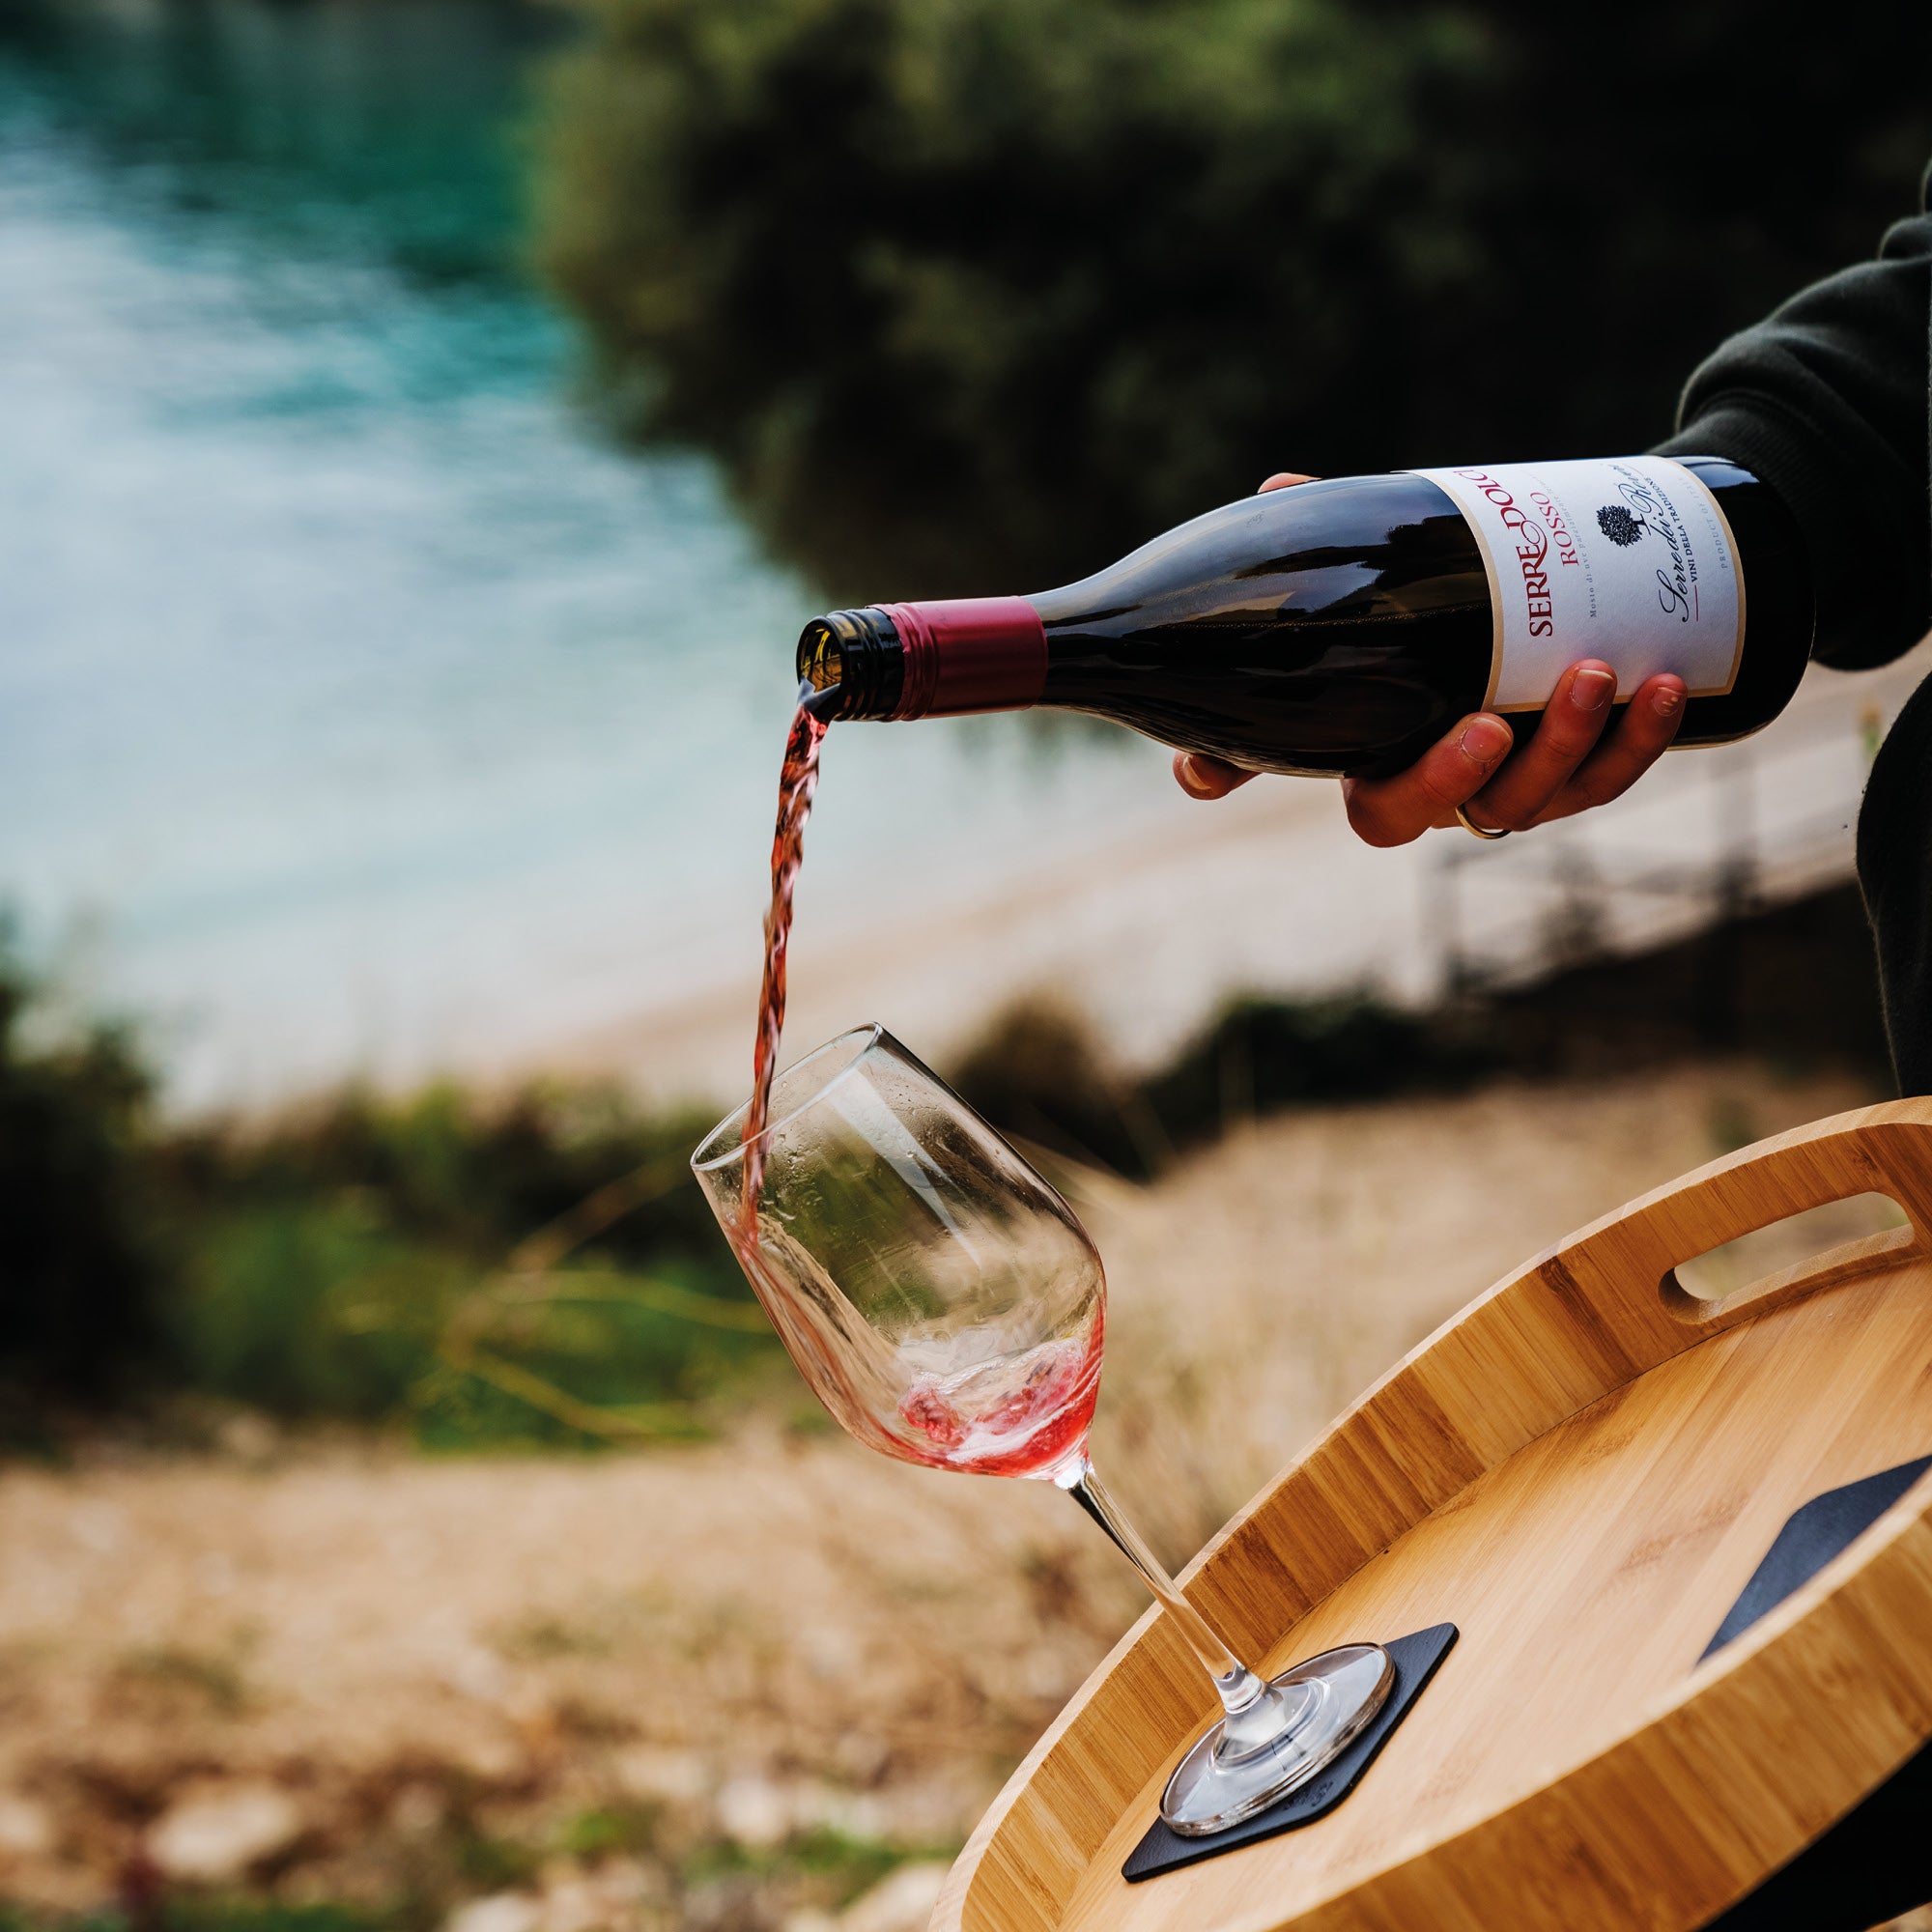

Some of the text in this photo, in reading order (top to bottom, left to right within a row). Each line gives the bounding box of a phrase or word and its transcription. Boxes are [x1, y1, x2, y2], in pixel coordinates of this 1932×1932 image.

[1530, 493, 1578, 566] ROSSO
[1644, 477, 1698, 582] VINI DELLA TRADIZIONE
[1706, 518, 1728, 568] PRODUCT
[1516, 520, 1553, 637] SERRE
